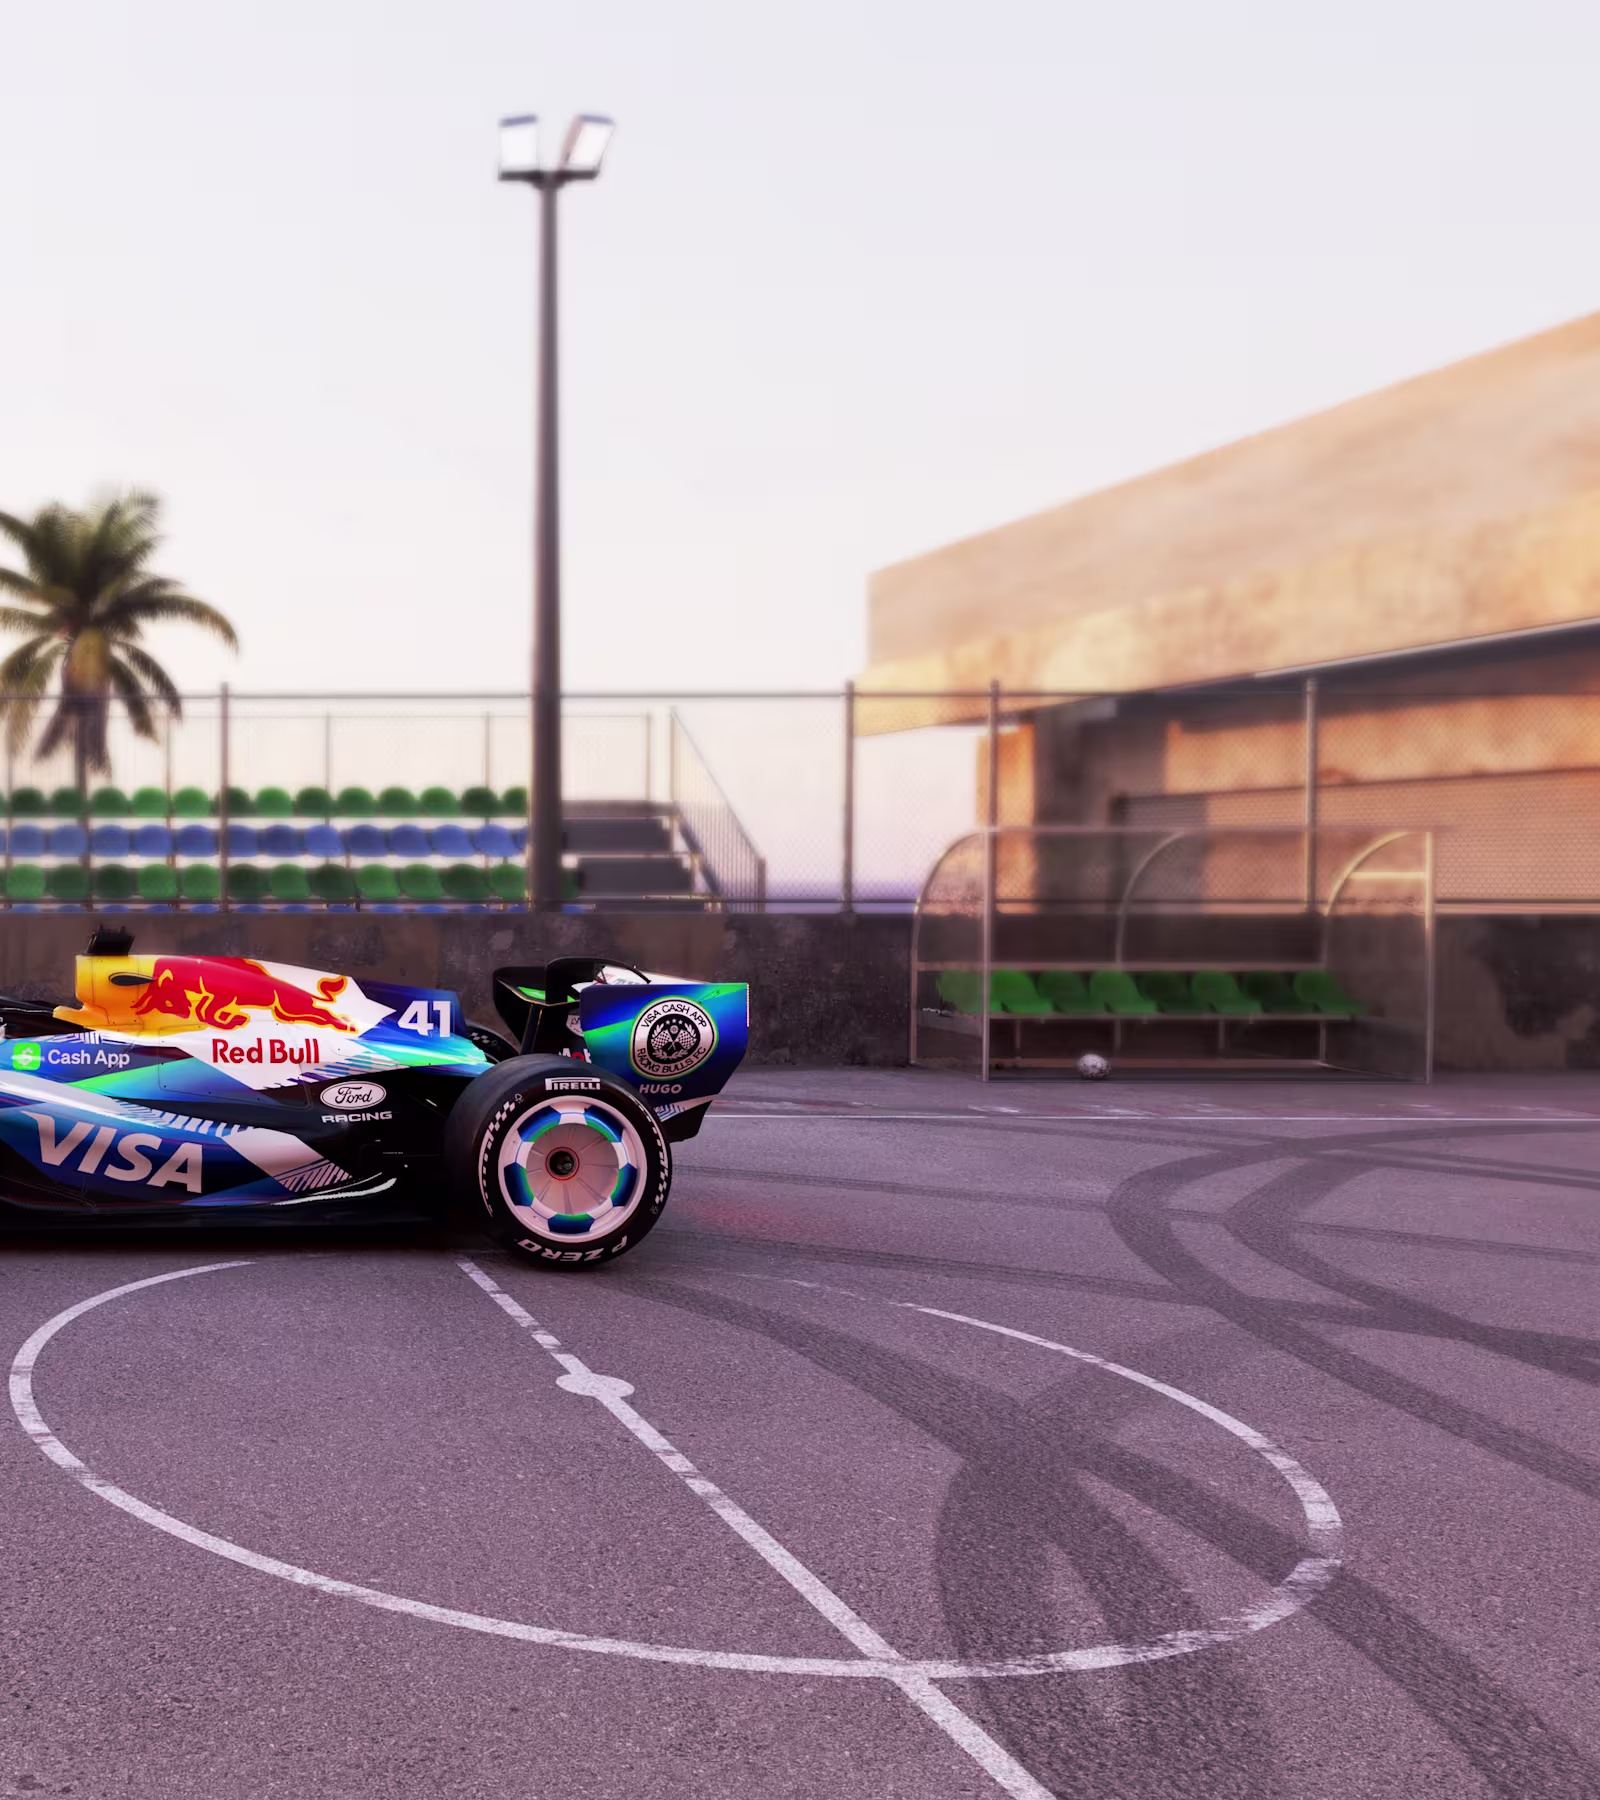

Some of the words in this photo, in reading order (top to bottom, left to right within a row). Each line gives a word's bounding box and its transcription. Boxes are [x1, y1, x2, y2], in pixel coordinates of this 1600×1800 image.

[397, 1000, 451, 1038] 41
[641, 1010, 662, 1029] VISA
[662, 1003, 691, 1015] CASH
[689, 1011, 708, 1028] APP
[47, 1049, 93, 1065] Cash
[94, 1050, 130, 1068] App
[211, 1038, 263, 1064] Red
[269, 1038, 320, 1064] Bull
[662, 1058, 694, 1073] BULLS
[544, 1077, 601, 1091] PIRELLI
[639, 1083, 683, 1094] HUGO
[334, 1086, 373, 1104] Ford
[321, 1111, 393, 1123] RACING
[19, 1110, 203, 1194] VISA
[516, 1238, 605, 1262] ZERO
[611, 1235, 628, 1253] P
